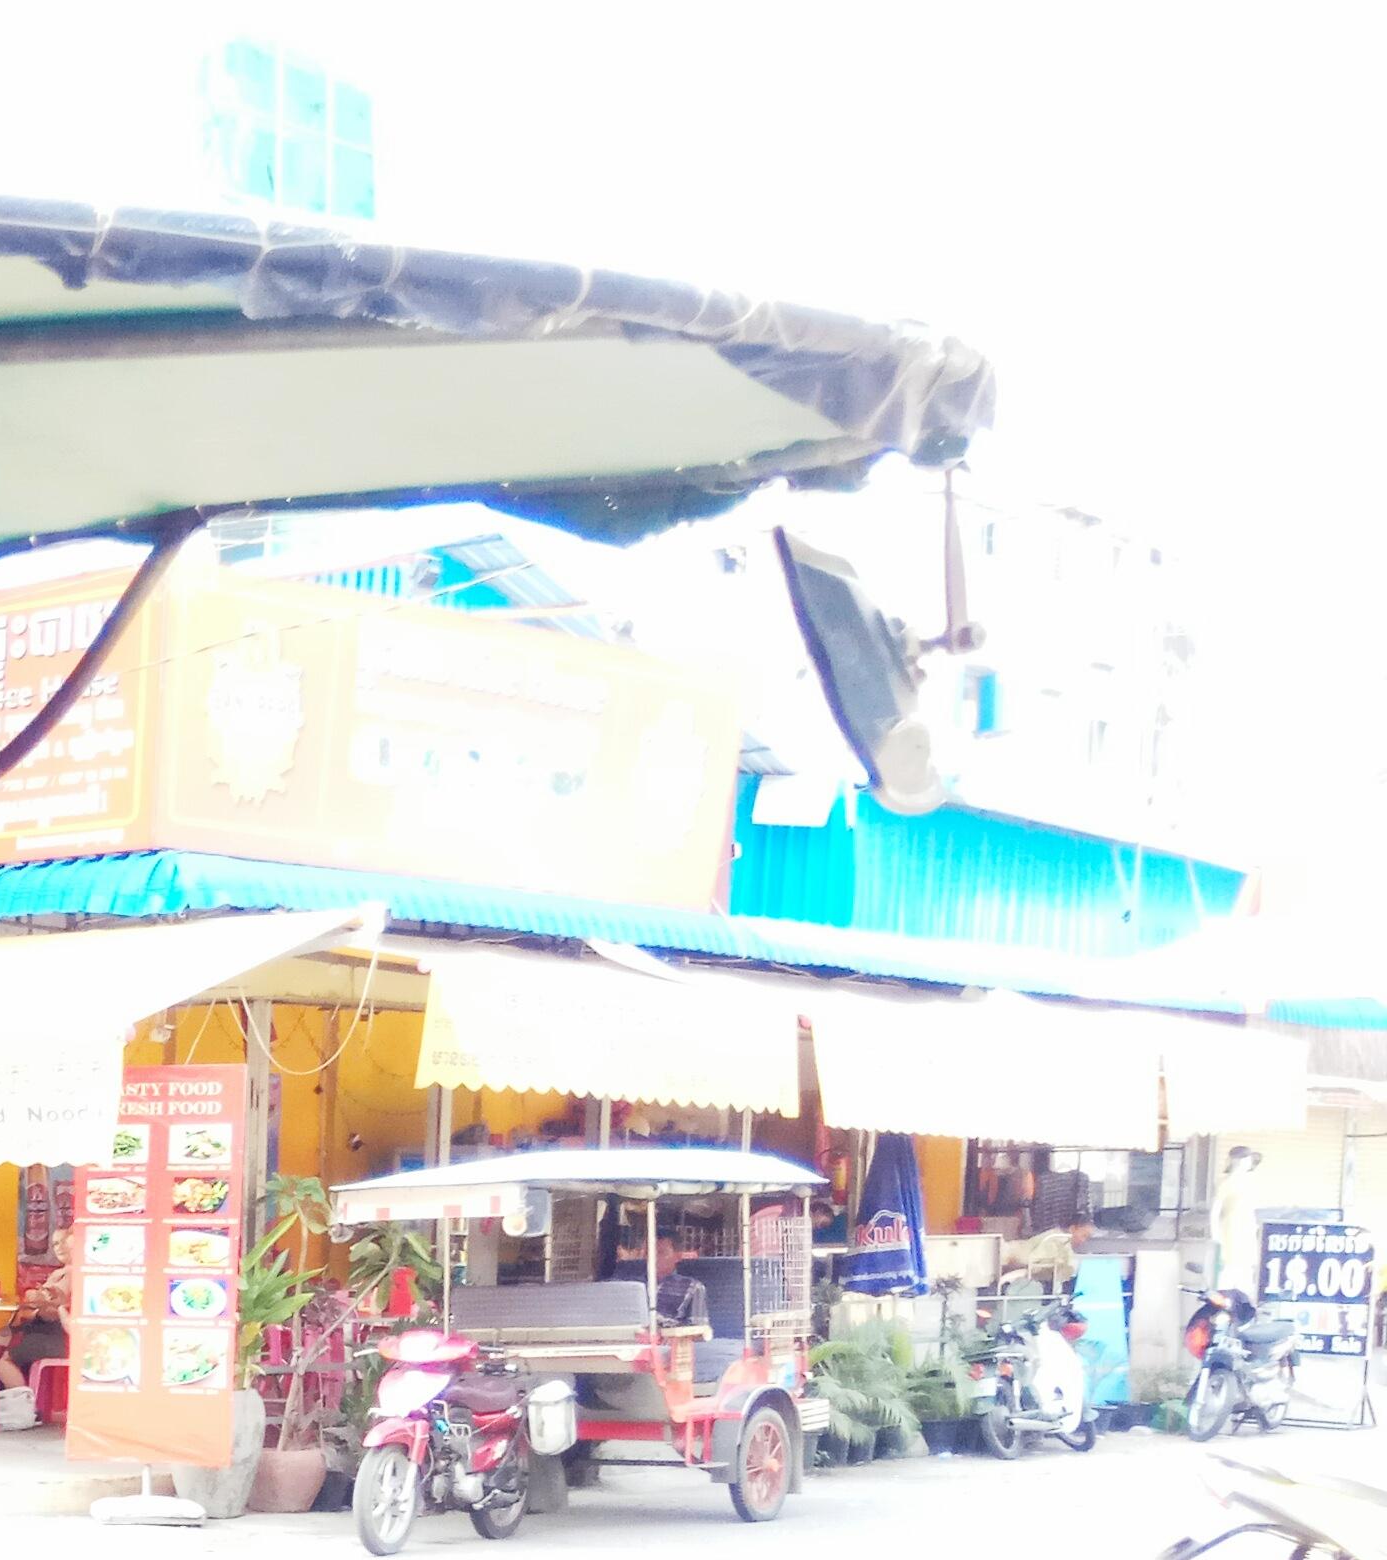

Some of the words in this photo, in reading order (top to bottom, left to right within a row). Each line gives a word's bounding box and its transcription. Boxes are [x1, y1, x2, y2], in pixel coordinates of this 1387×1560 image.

[39, 673, 120, 703] Hse
[168, 1081, 223, 1096] FOOD
[167, 1101, 223, 1115] FOOD
[1331, 1336, 1362, 1353] Sale
